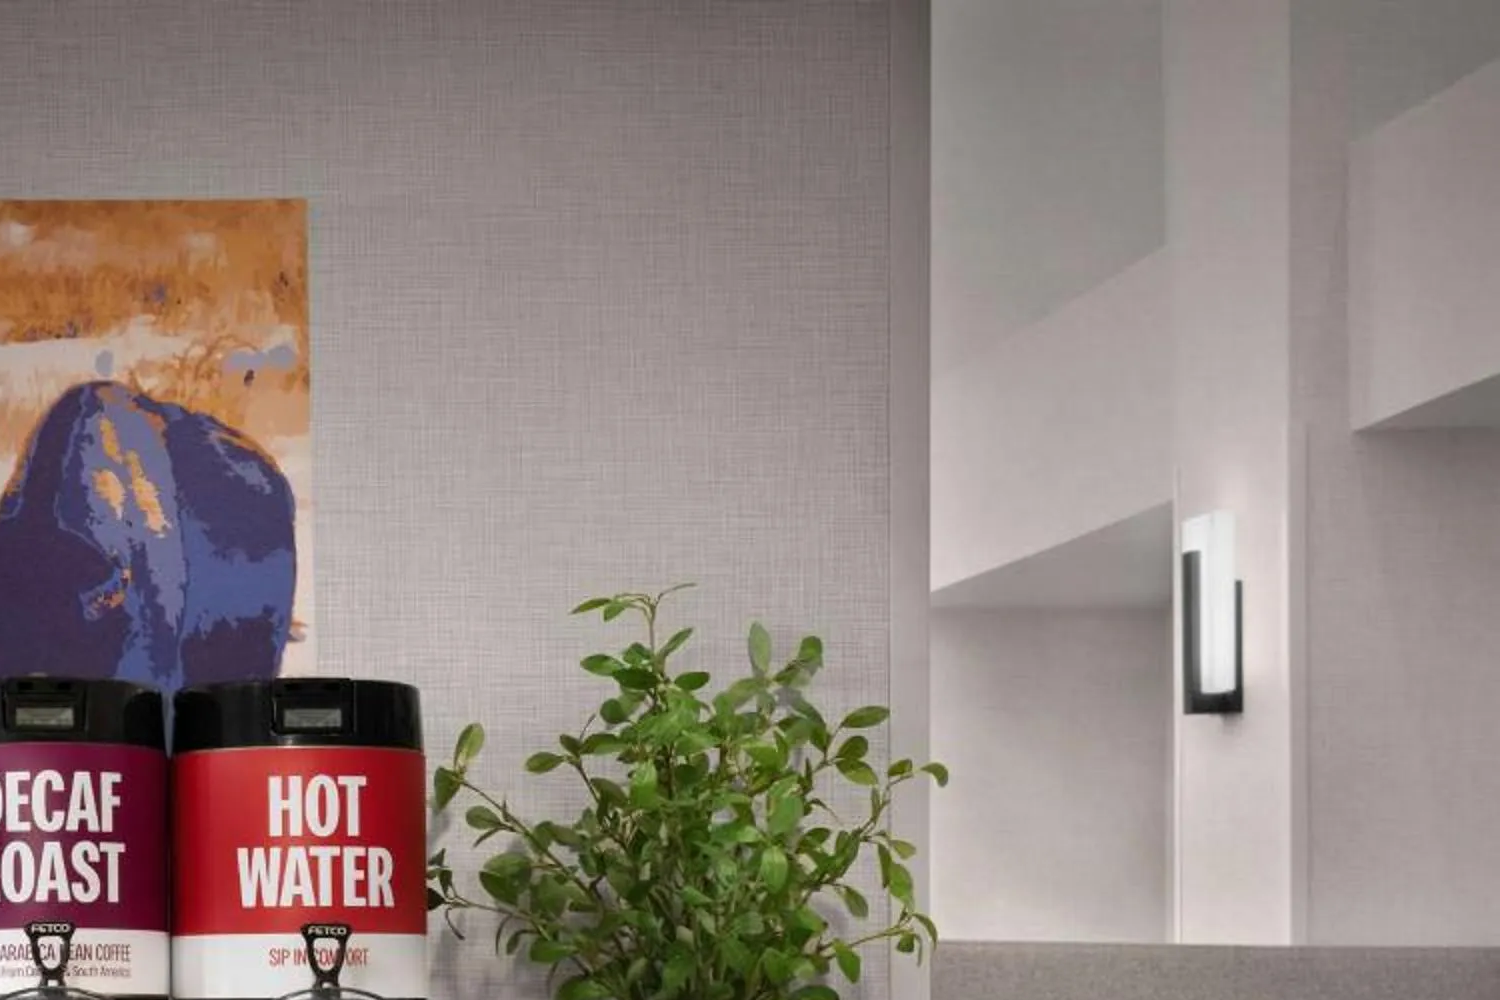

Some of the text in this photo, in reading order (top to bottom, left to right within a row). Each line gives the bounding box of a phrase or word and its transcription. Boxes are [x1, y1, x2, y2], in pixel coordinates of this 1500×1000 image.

[267, 774, 367, 838] HOT
[236, 846, 395, 909] WATER
[31, 923, 71, 933] FETCO
[307, 925, 348, 935] FETCO
[95, 943, 132, 962] COFFEE
[269, 947, 291, 966] SIP
[293, 947, 307, 966] IN
